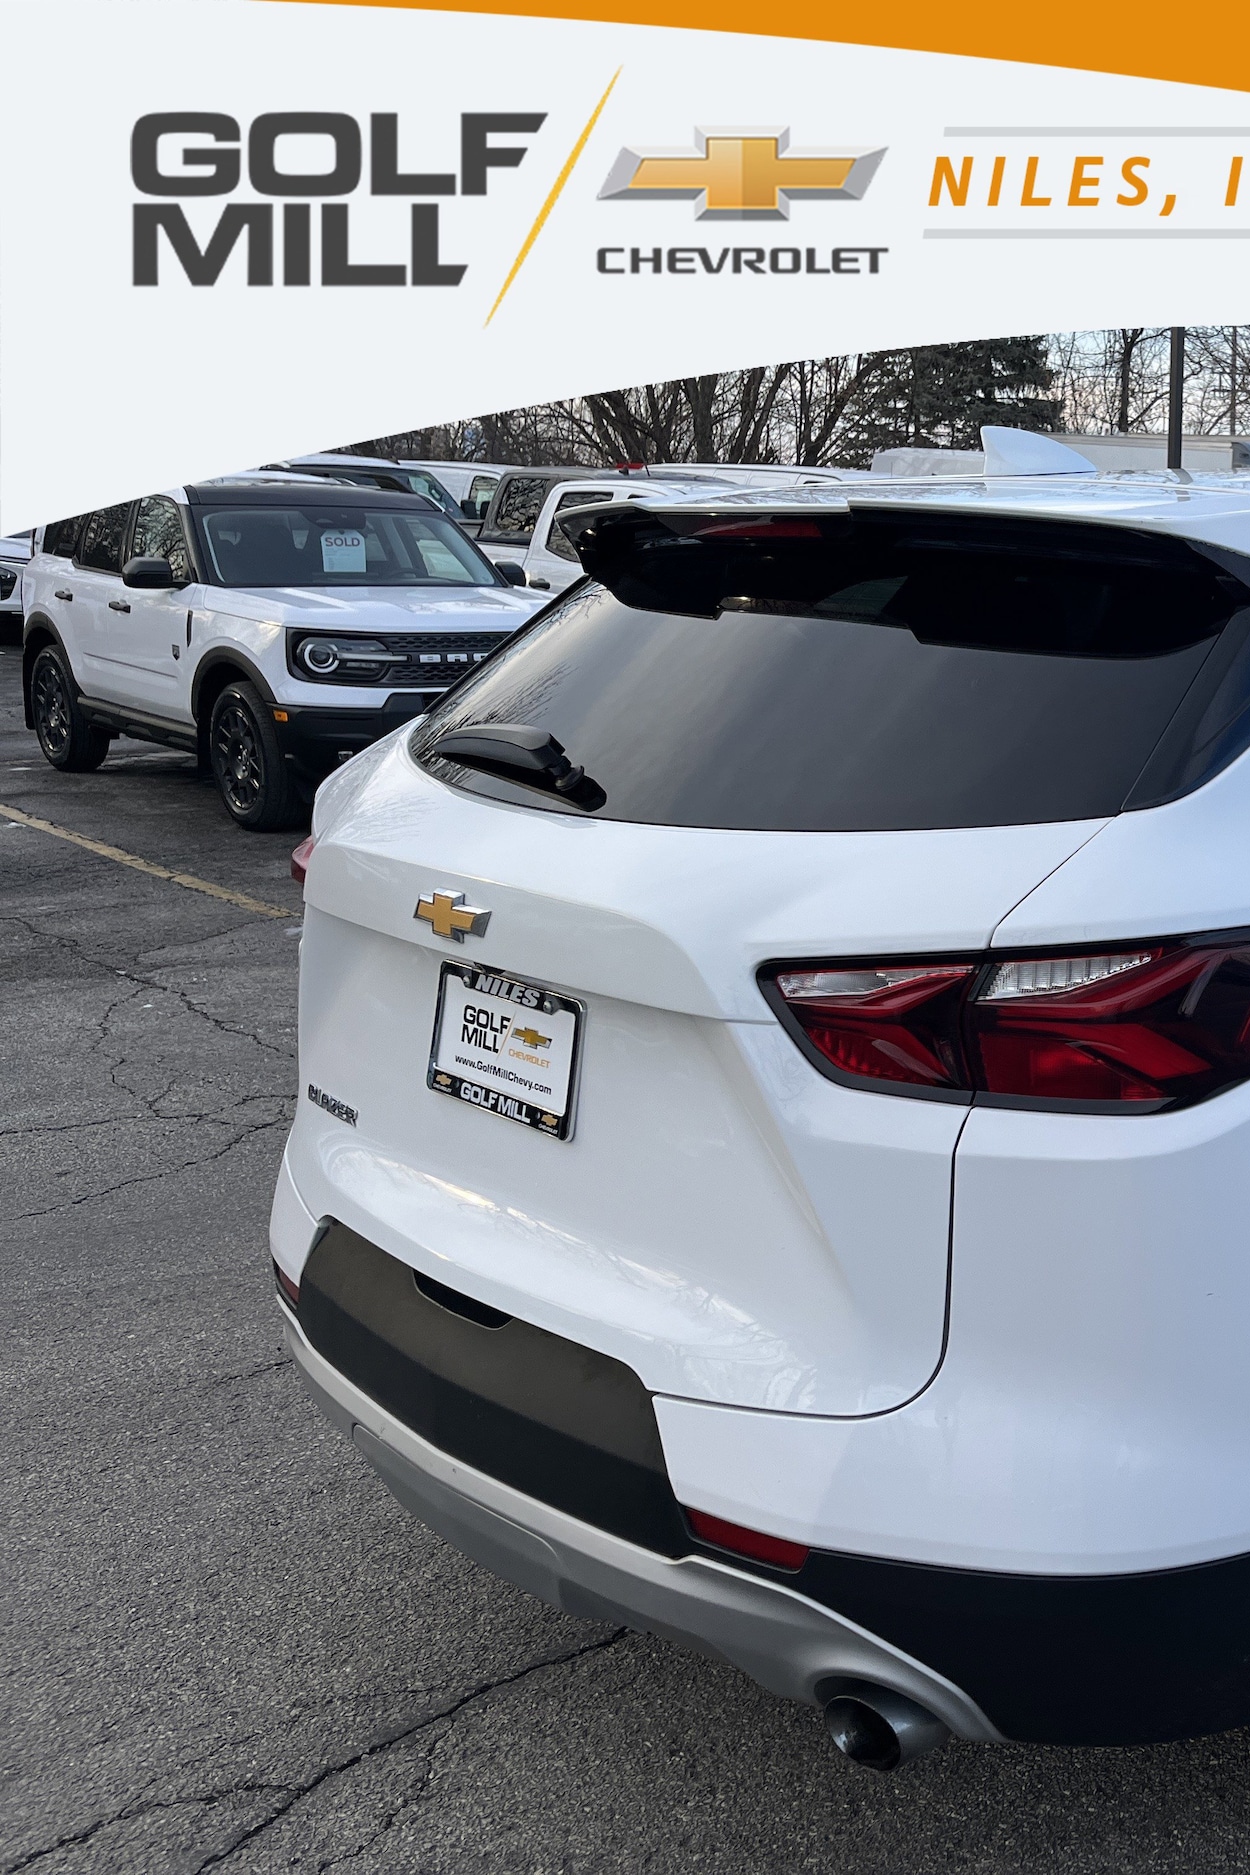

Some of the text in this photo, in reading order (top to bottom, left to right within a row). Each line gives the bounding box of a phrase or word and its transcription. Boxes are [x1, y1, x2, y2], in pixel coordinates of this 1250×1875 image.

[325, 537, 361, 547] SOLD
[475, 974, 541, 1007] NILES
[463, 1004, 511, 1035] GOLF
[461, 1023, 500, 1054] MILL
[508, 1048, 551, 1069] CHEVROLET
[455, 1054, 552, 1096] www.GolfMillChevy.com
[460, 1081, 531, 1124] GOLF MILL
